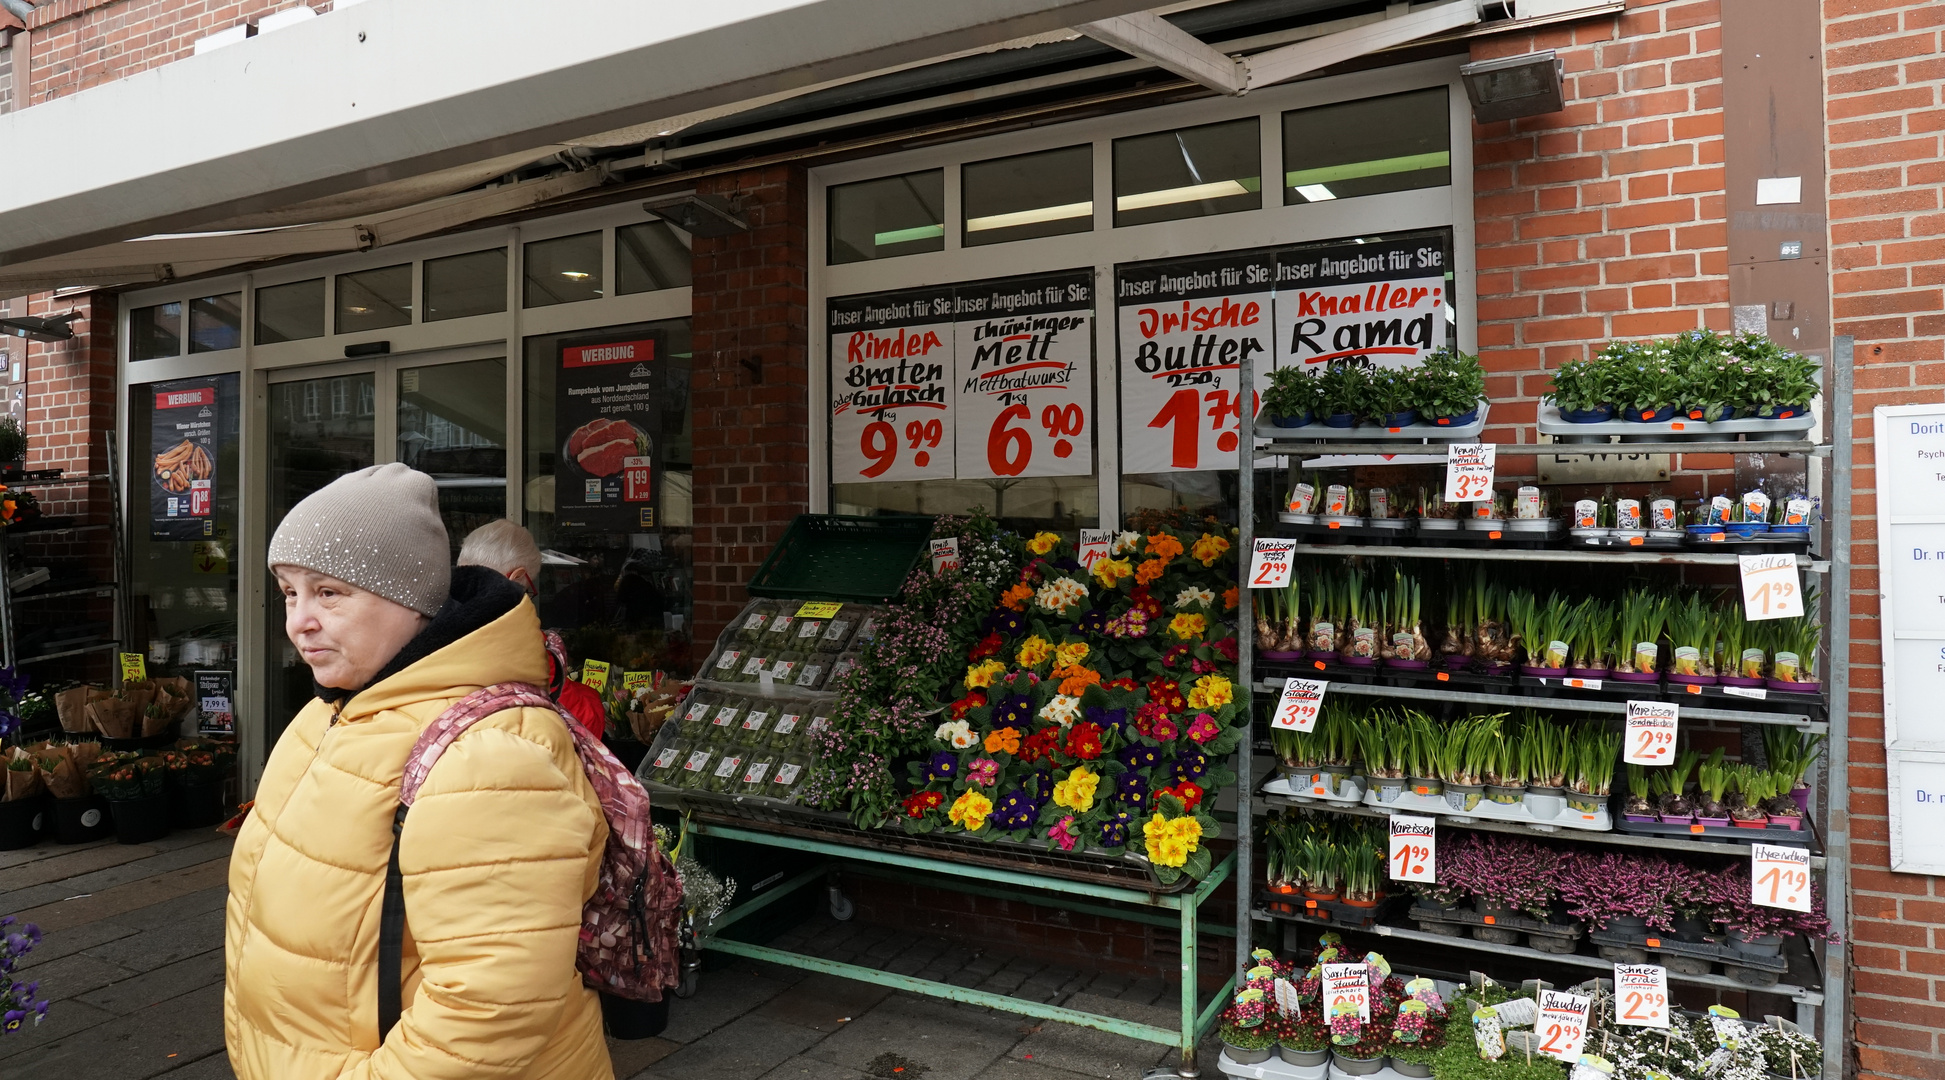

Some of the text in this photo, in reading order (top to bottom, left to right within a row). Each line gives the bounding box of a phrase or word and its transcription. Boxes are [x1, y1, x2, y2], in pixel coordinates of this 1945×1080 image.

[1320, 254, 1385, 280] Angebot
[1388, 250, 1414, 271] für
[1160, 271, 1218, 296] Angebot
[1220, 268, 1243, 287] für
[954, 296, 989, 314] Unser
[992, 290, 1042, 312] Angebot
[1045, 286, 1064, 304] für
[1296, 282, 1442, 318] Knaller:
[832, 310, 862, 326] Unser
[865, 303, 912, 325] Angebot
[913, 300, 931, 317] für
[1290, 312, 1433, 355] Rama
[582, 345, 634, 363] WERBUNG
[971, 332, 1059, 370] Mett
[1134, 334, 1265, 374] Butter
[845, 358, 943, 388] Braten
[168, 392, 202, 406] WERBUNG
[568, 386, 600, 396] Rumpsteak
[852, 383, 944, 407] Gulasch
[1911, 422, 1944, 434] Dorit
[1082, 531, 1110, 544] Primeln
[1914, 548, 1932, 560] Dr.
[1742, 556, 1793, 574] Scilla
[624, 674, 650, 682] Tulpen
[1288, 680, 1319, 691] Oster
[1916, 790, 1934, 803] Dr.
[1391, 820, 1434, 836] Narzissen
[1616, 964, 1659, 976] Schnee
[1621, 975, 1660, 984] Heide
